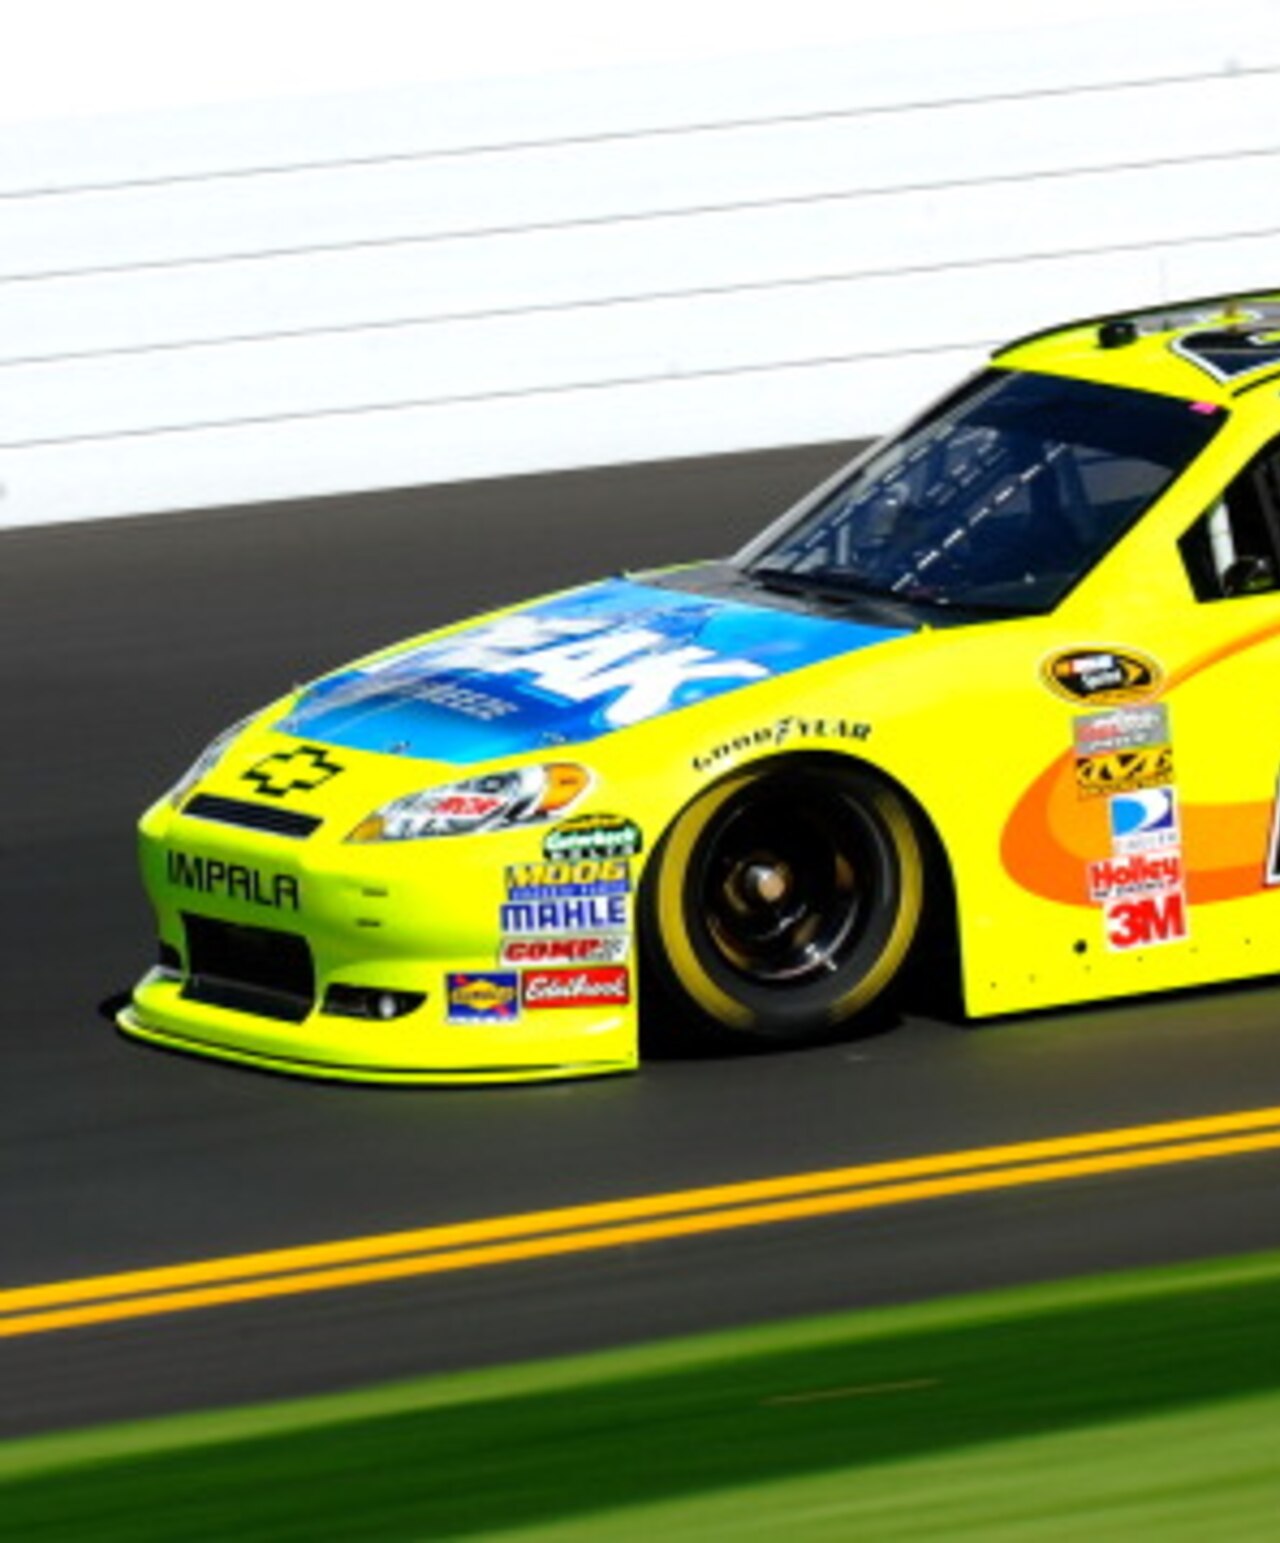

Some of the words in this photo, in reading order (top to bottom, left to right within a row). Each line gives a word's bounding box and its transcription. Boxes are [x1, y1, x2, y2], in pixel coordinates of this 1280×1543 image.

[167, 848, 300, 912] IMPALA
[507, 861, 628, 888] MOOG
[1090, 854, 1180, 890] Holley
[501, 896, 626, 932] MAHLE
[1108, 893, 1187, 948] 3M
